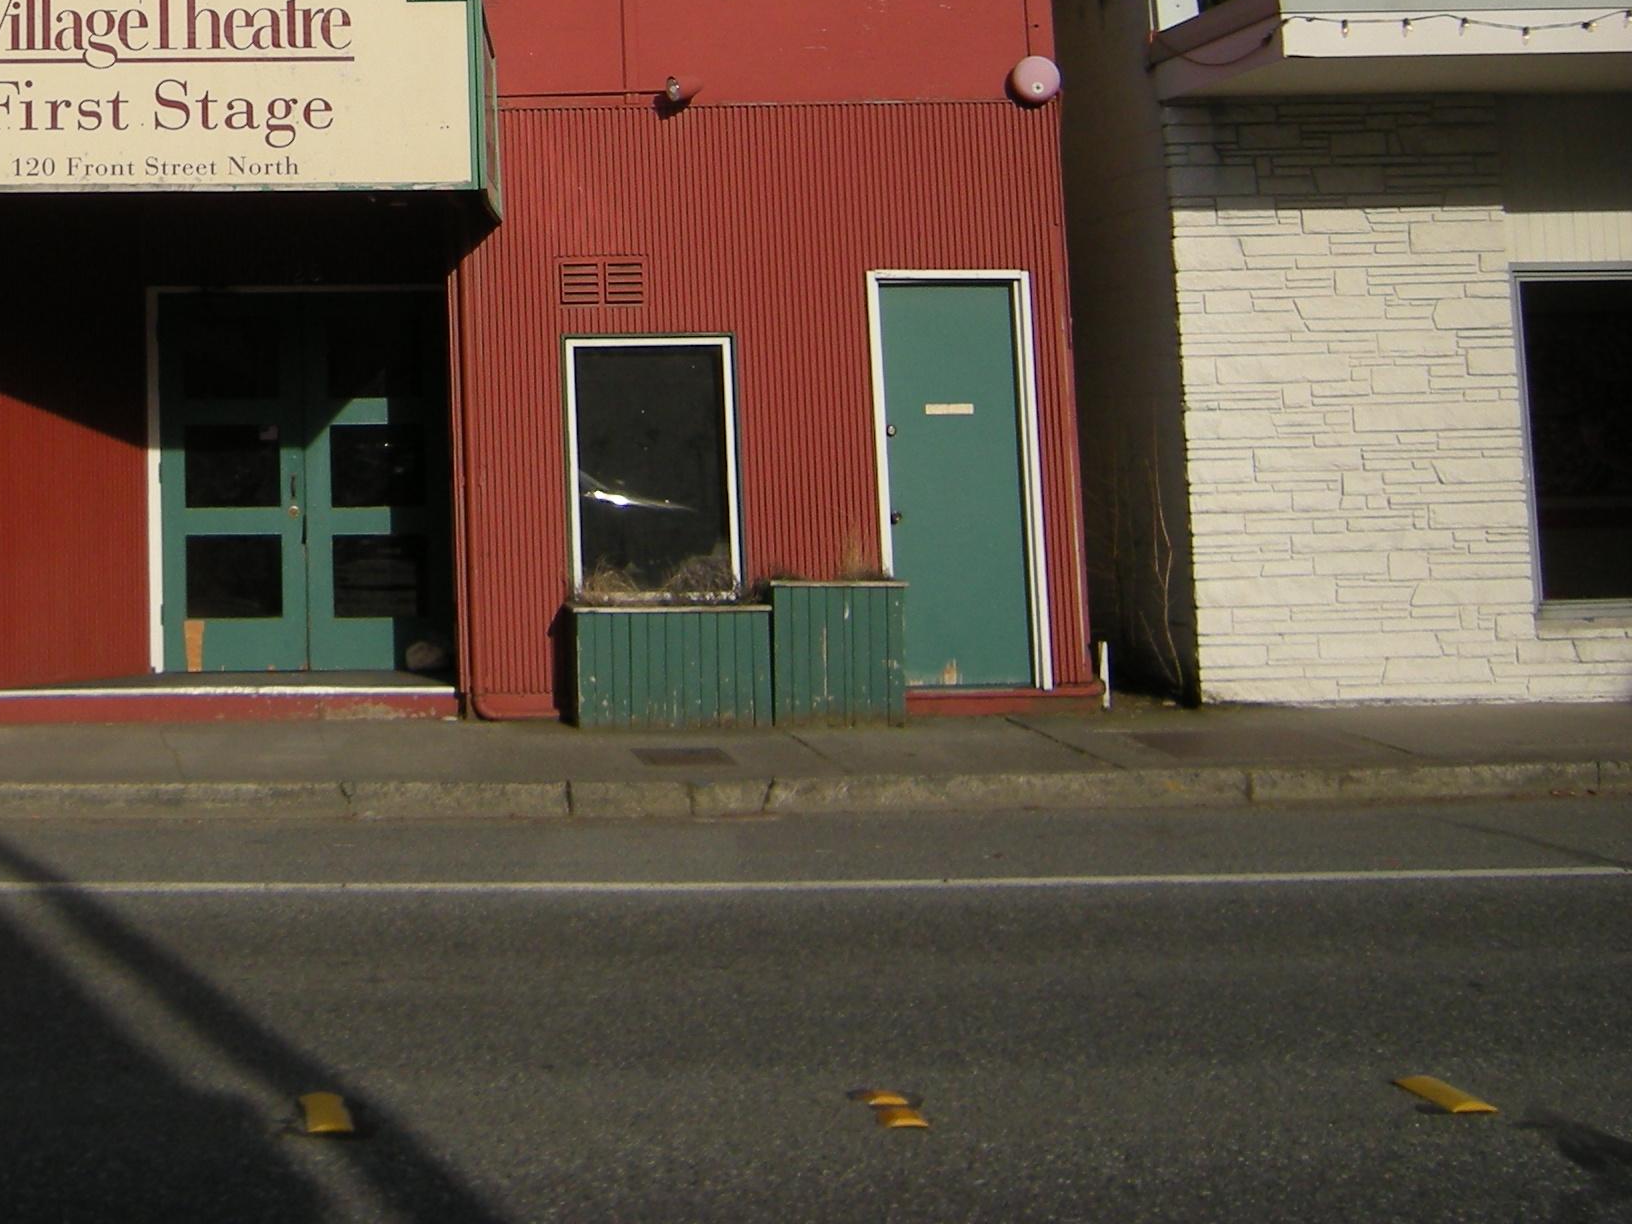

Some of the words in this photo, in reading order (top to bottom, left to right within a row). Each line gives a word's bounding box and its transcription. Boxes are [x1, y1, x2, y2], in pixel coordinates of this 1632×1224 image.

[154, 78, 335, 149] Stage
[12, 156, 56, 177] 120
[65, 156, 135, 177] Front
[144, 156, 217, 177] Street
[227, 155, 299, 177] North
